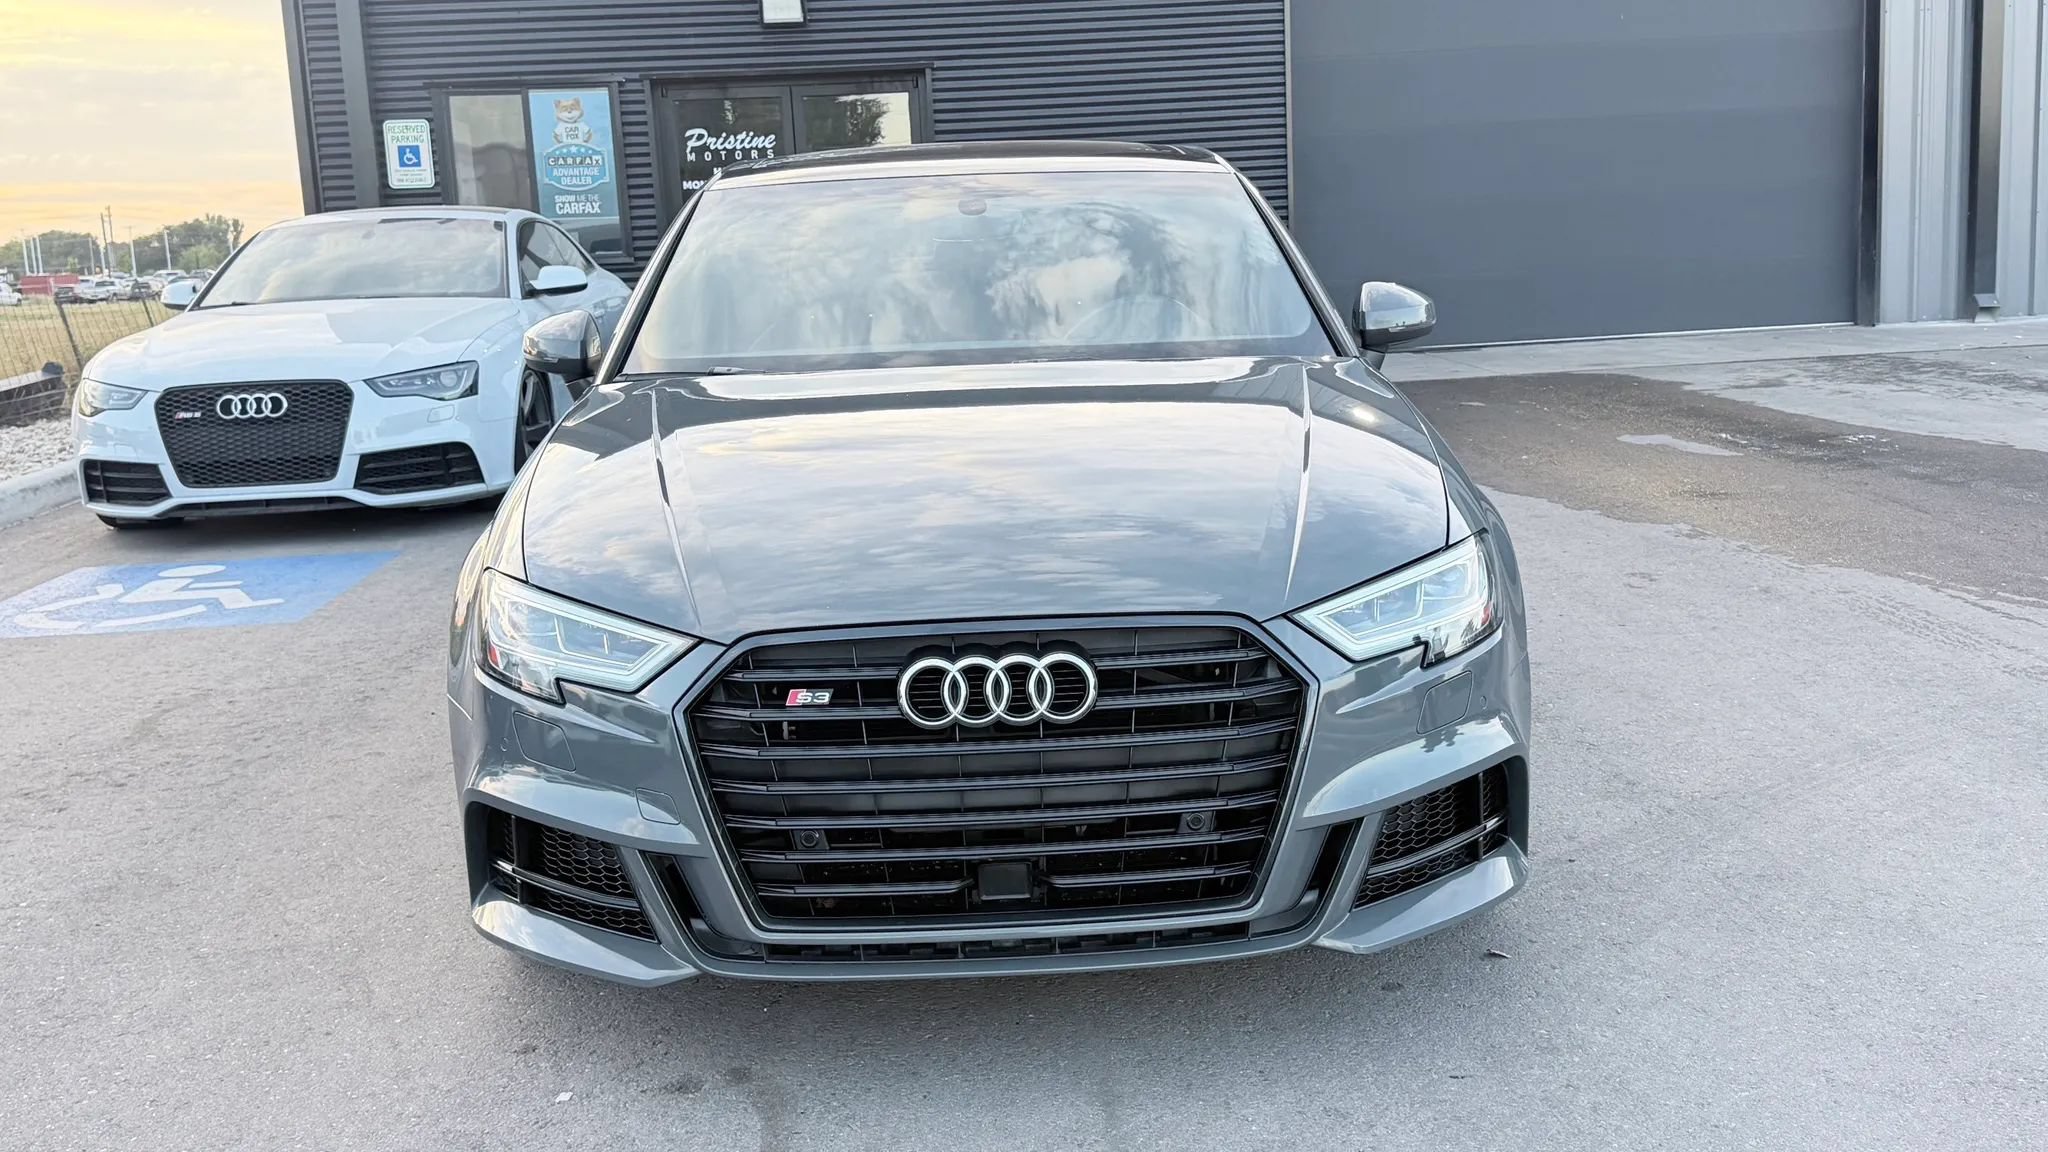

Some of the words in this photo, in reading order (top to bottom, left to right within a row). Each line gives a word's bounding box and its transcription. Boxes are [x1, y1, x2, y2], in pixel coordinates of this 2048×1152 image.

[388, 125, 425, 134] RESERVED
[391, 135, 424, 143] PARKING
[684, 128, 776, 153] Pristine
[687, 149, 774, 162] MOTORS
[548, 155, 602, 166] CARFAX
[553, 167, 600, 176] ADVANTAGE
[561, 176, 592, 185] DEALER
[555, 195, 575, 203] SHOW
[576, 194, 587, 202] ME
[588, 194, 600, 202] THE
[555, 203, 600, 215] CARFAX
